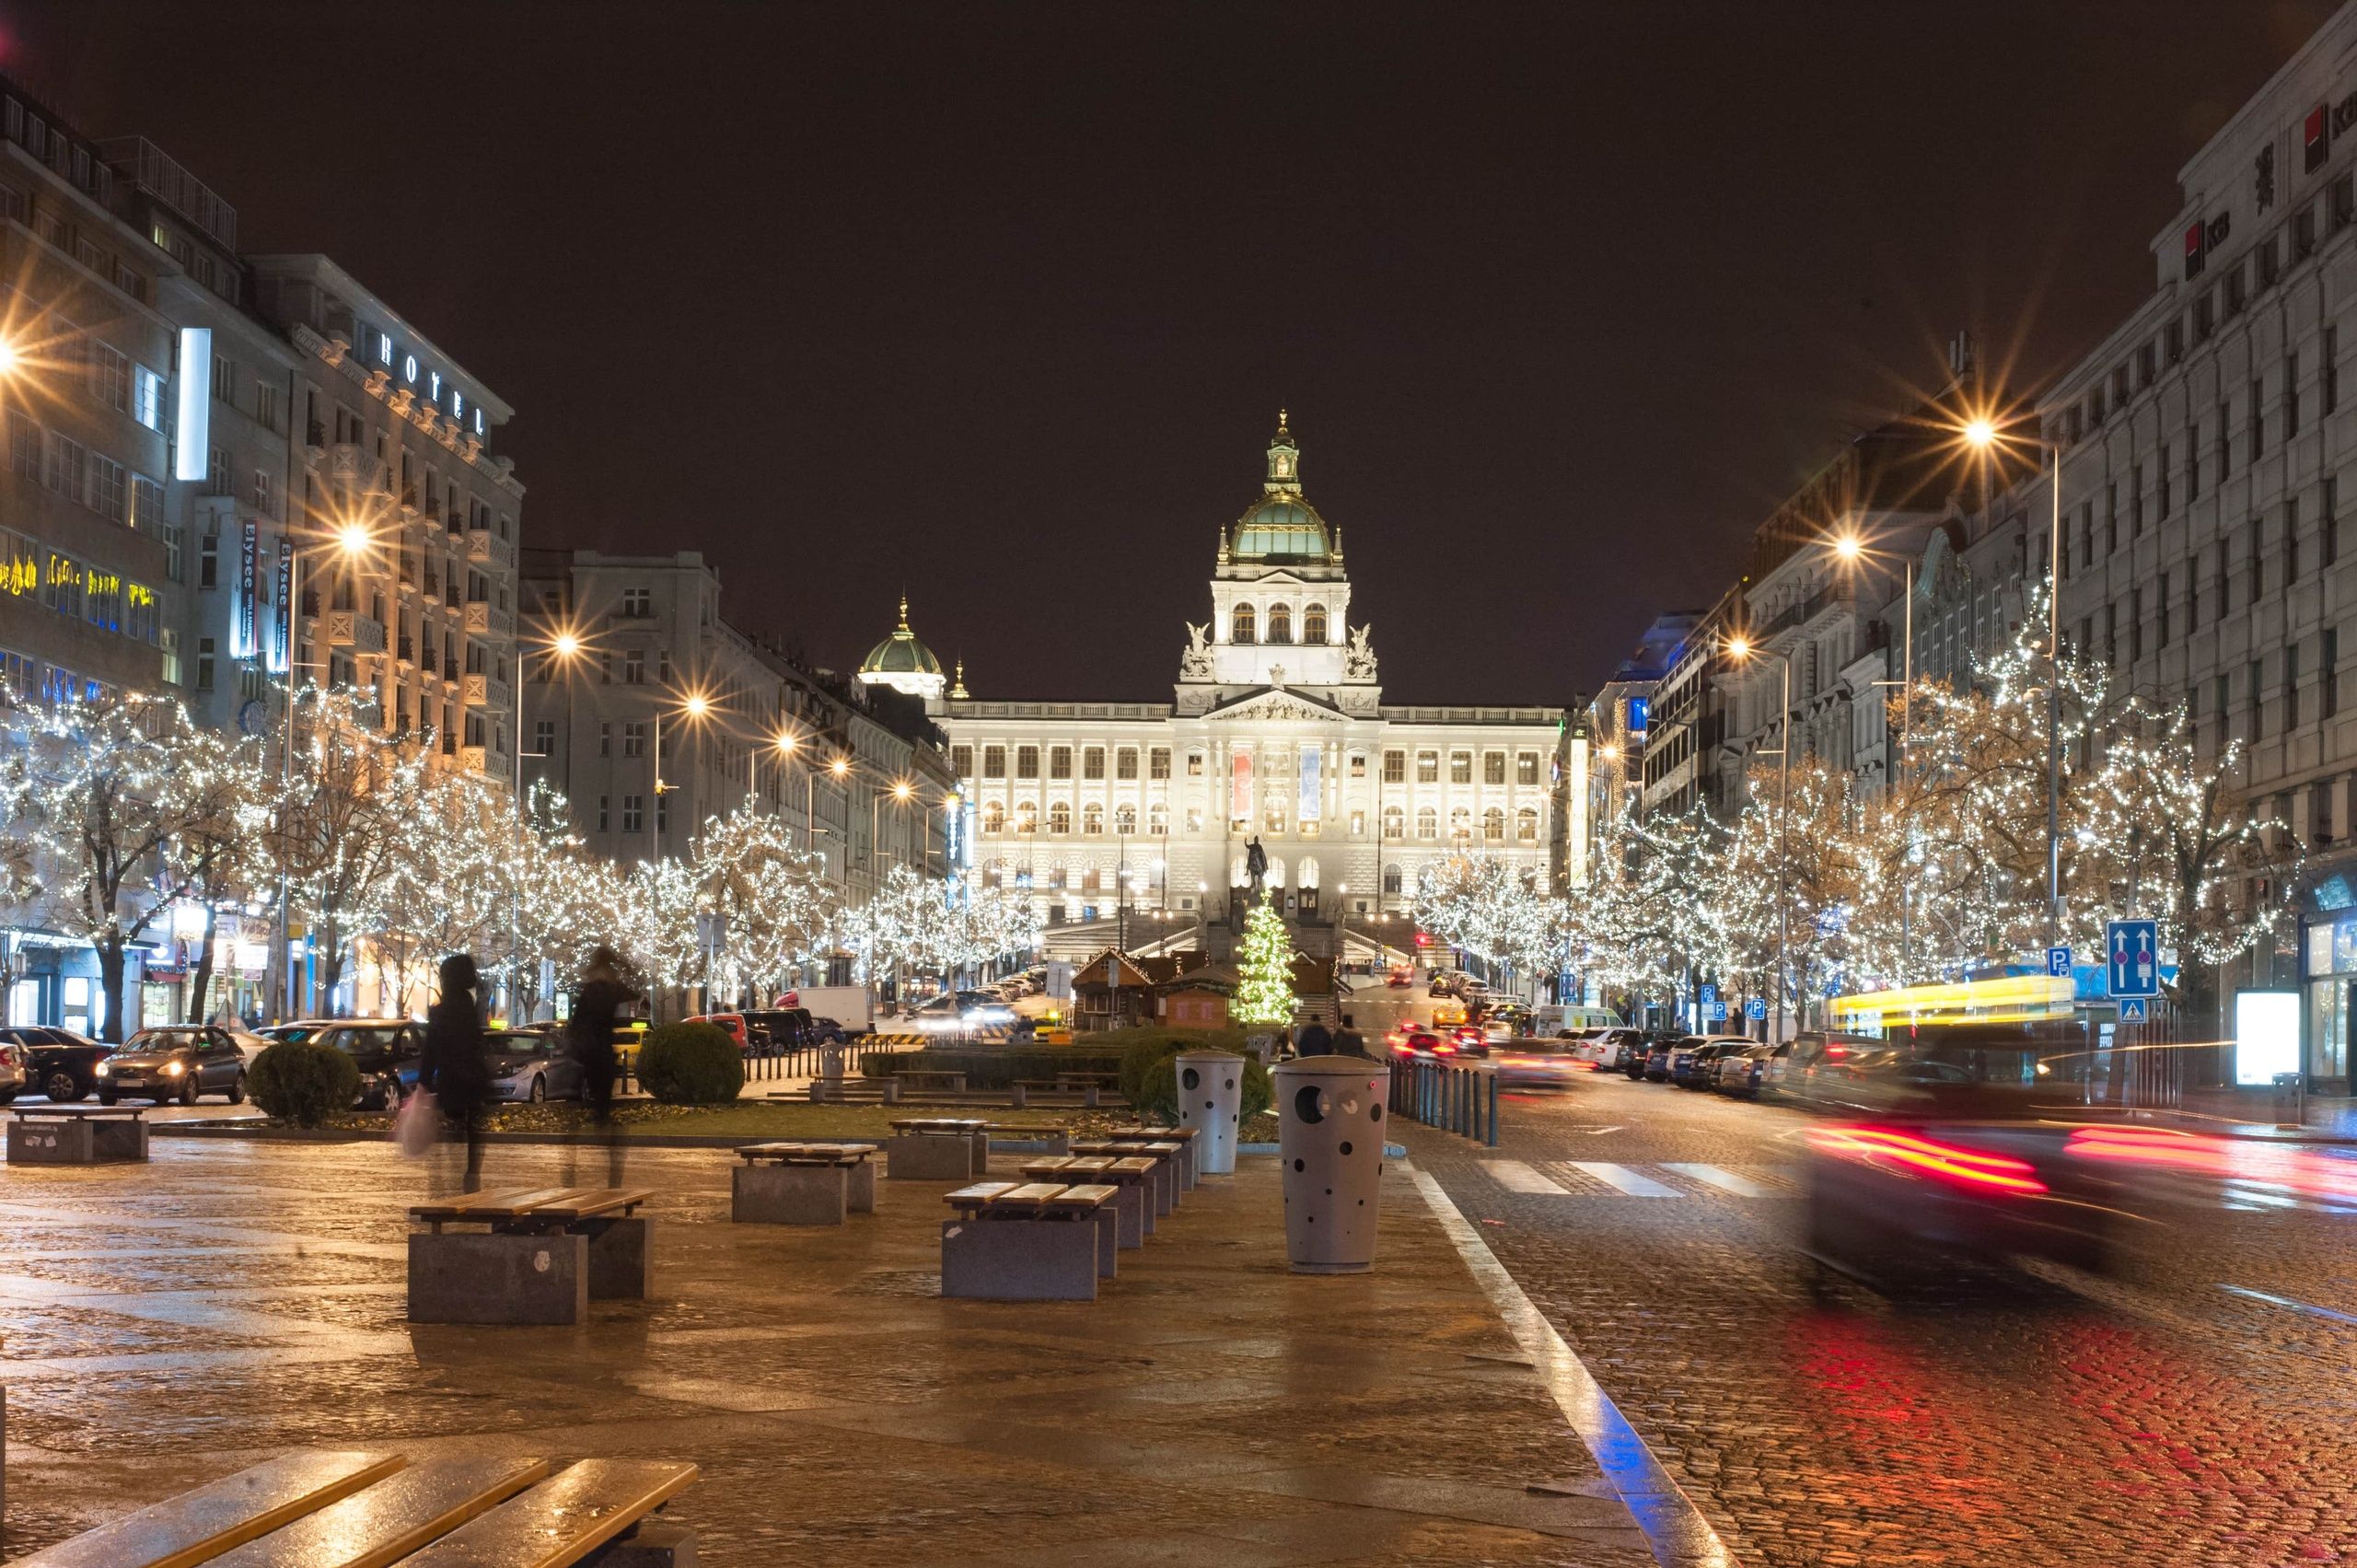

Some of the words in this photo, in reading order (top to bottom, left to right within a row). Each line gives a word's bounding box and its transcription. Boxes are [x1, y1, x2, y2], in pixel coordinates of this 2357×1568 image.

[380, 333, 483, 436] HOTEL
[243, 524, 256, 588] Elysee
[278, 543, 292, 606] Elysee
[2052, 951, 2066, 970] P
[1715, 1004, 1724, 1015] P
[1753, 1001, 1762, 1013] P
